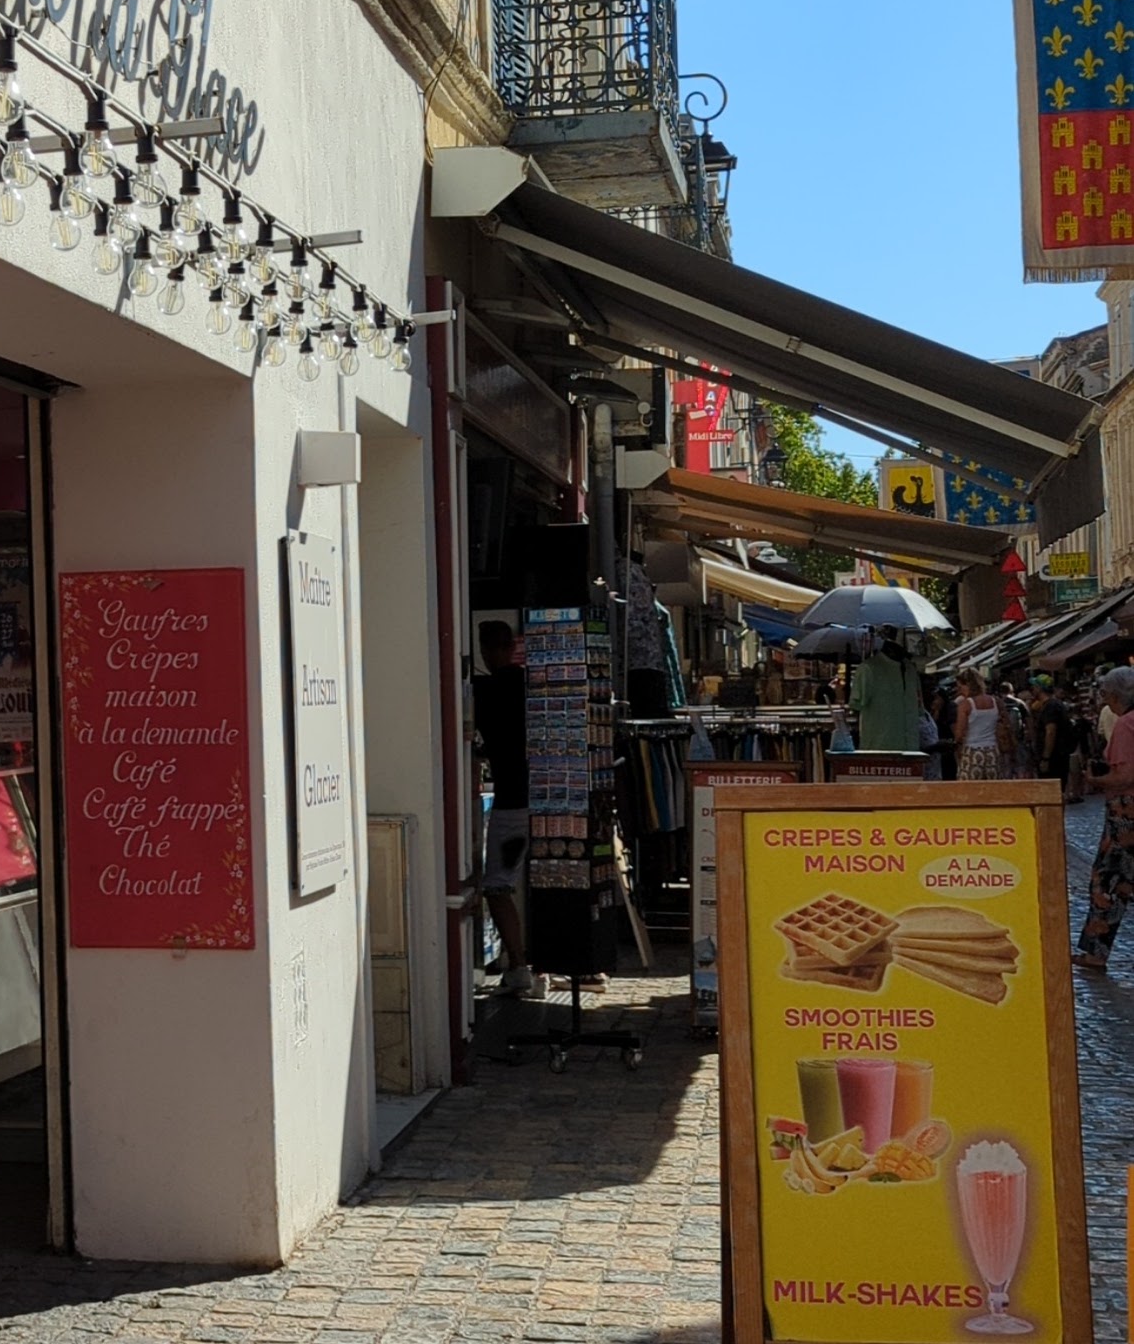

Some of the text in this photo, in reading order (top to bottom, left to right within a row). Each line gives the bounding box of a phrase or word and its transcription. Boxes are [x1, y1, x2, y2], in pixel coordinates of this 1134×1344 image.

[299, 561, 331, 607] Maître
[98, 598, 209, 640] Gaufres
[106, 638, 199, 683] Crêpes
[105, 685, 197, 708] maison
[302, 664, 337, 707] Artisan
[79, 718, 238, 745] à la demande
[112, 751, 177, 790] Café
[707, 775, 782, 785] BILLETTERIE
[849, 765, 912, 775] BILLETTERIE
[304, 764, 340, 807] Glacier
[83, 788, 238, 831] Café frappé
[115, 826, 171, 858] Thé
[764, 827, 1017, 848] CREPES & GAUFRES
[804, 855, 906, 873] MAISON
[947, 858, 991, 871] A LA
[99, 864, 204, 896] Chocolat
[925, 874, 1015, 888] DEMANDE
[784, 1009, 935, 1028] SMOOTHIES
[822, 1032, 899, 1052] FRAIS
[773, 1280, 983, 1308] MILK-SHAKES
